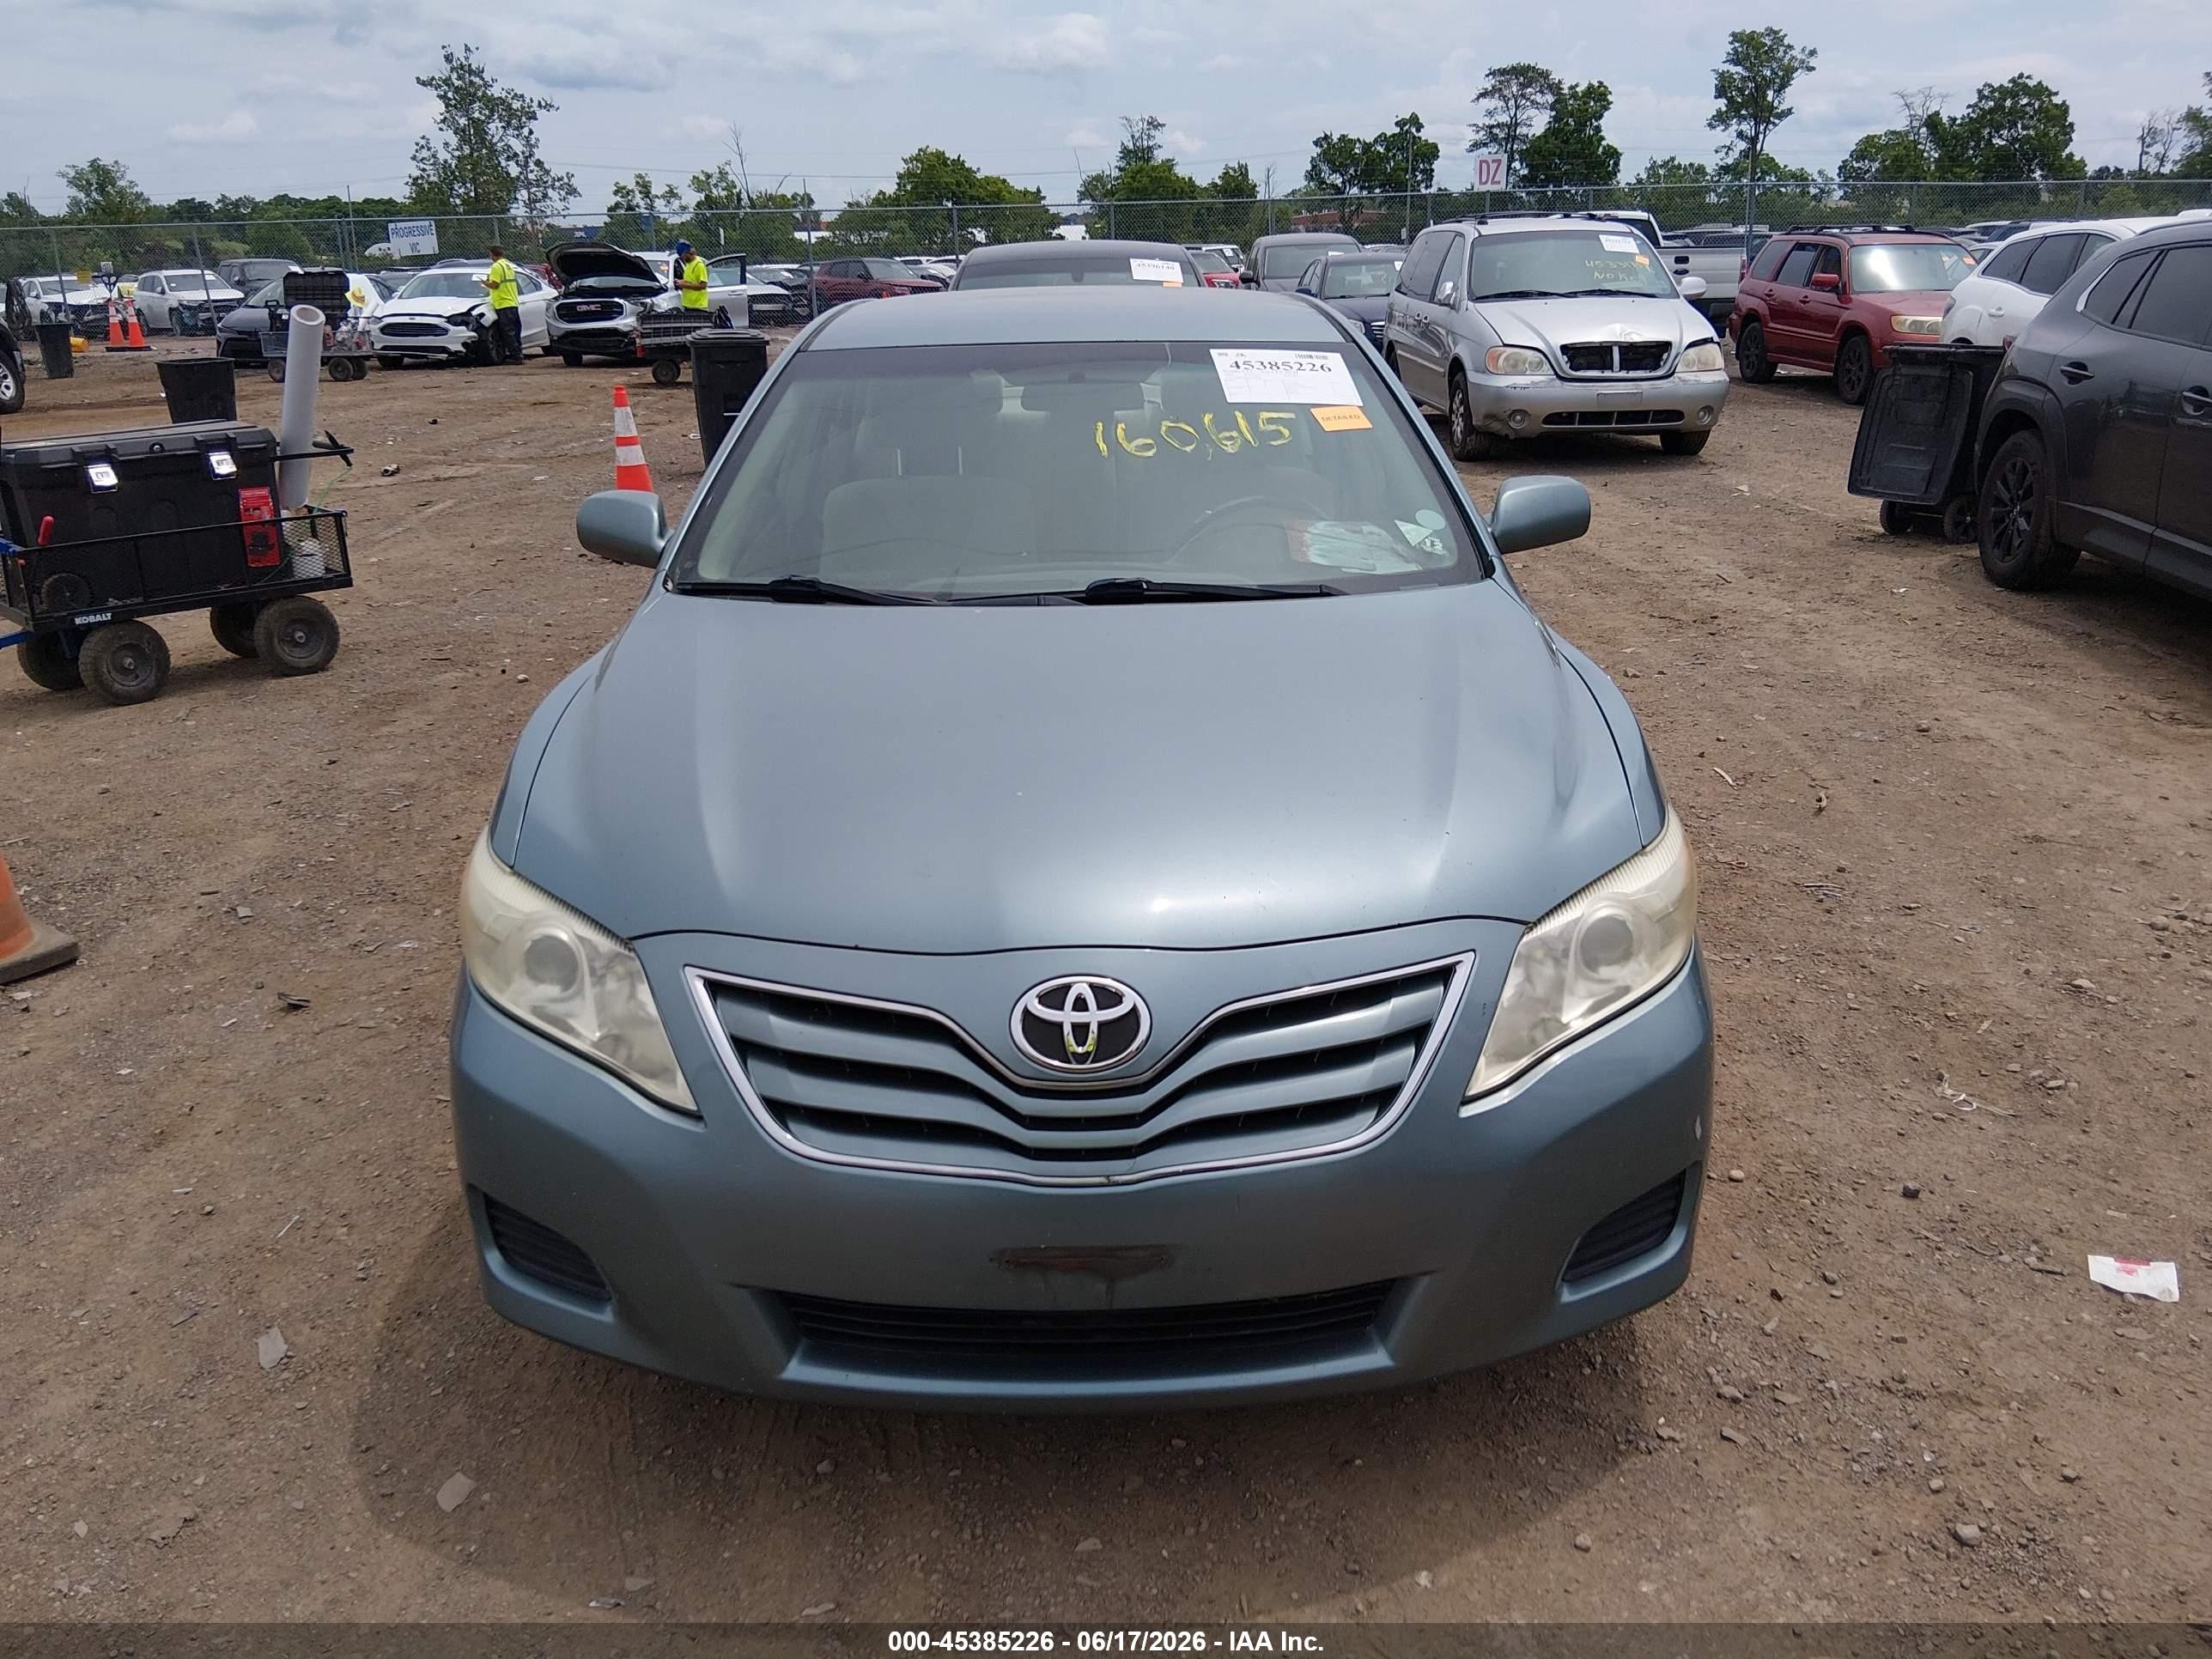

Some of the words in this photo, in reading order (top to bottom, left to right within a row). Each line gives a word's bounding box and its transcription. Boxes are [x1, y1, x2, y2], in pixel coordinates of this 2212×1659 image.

[1479, 159, 1502, 185] DZ
[391, 224, 435, 240] PROGRESSIVE
[1229, 360, 1333, 373] 45385226
[1095, 410, 1296, 461] 160,615
[75, 612, 112, 625] KOBALT
